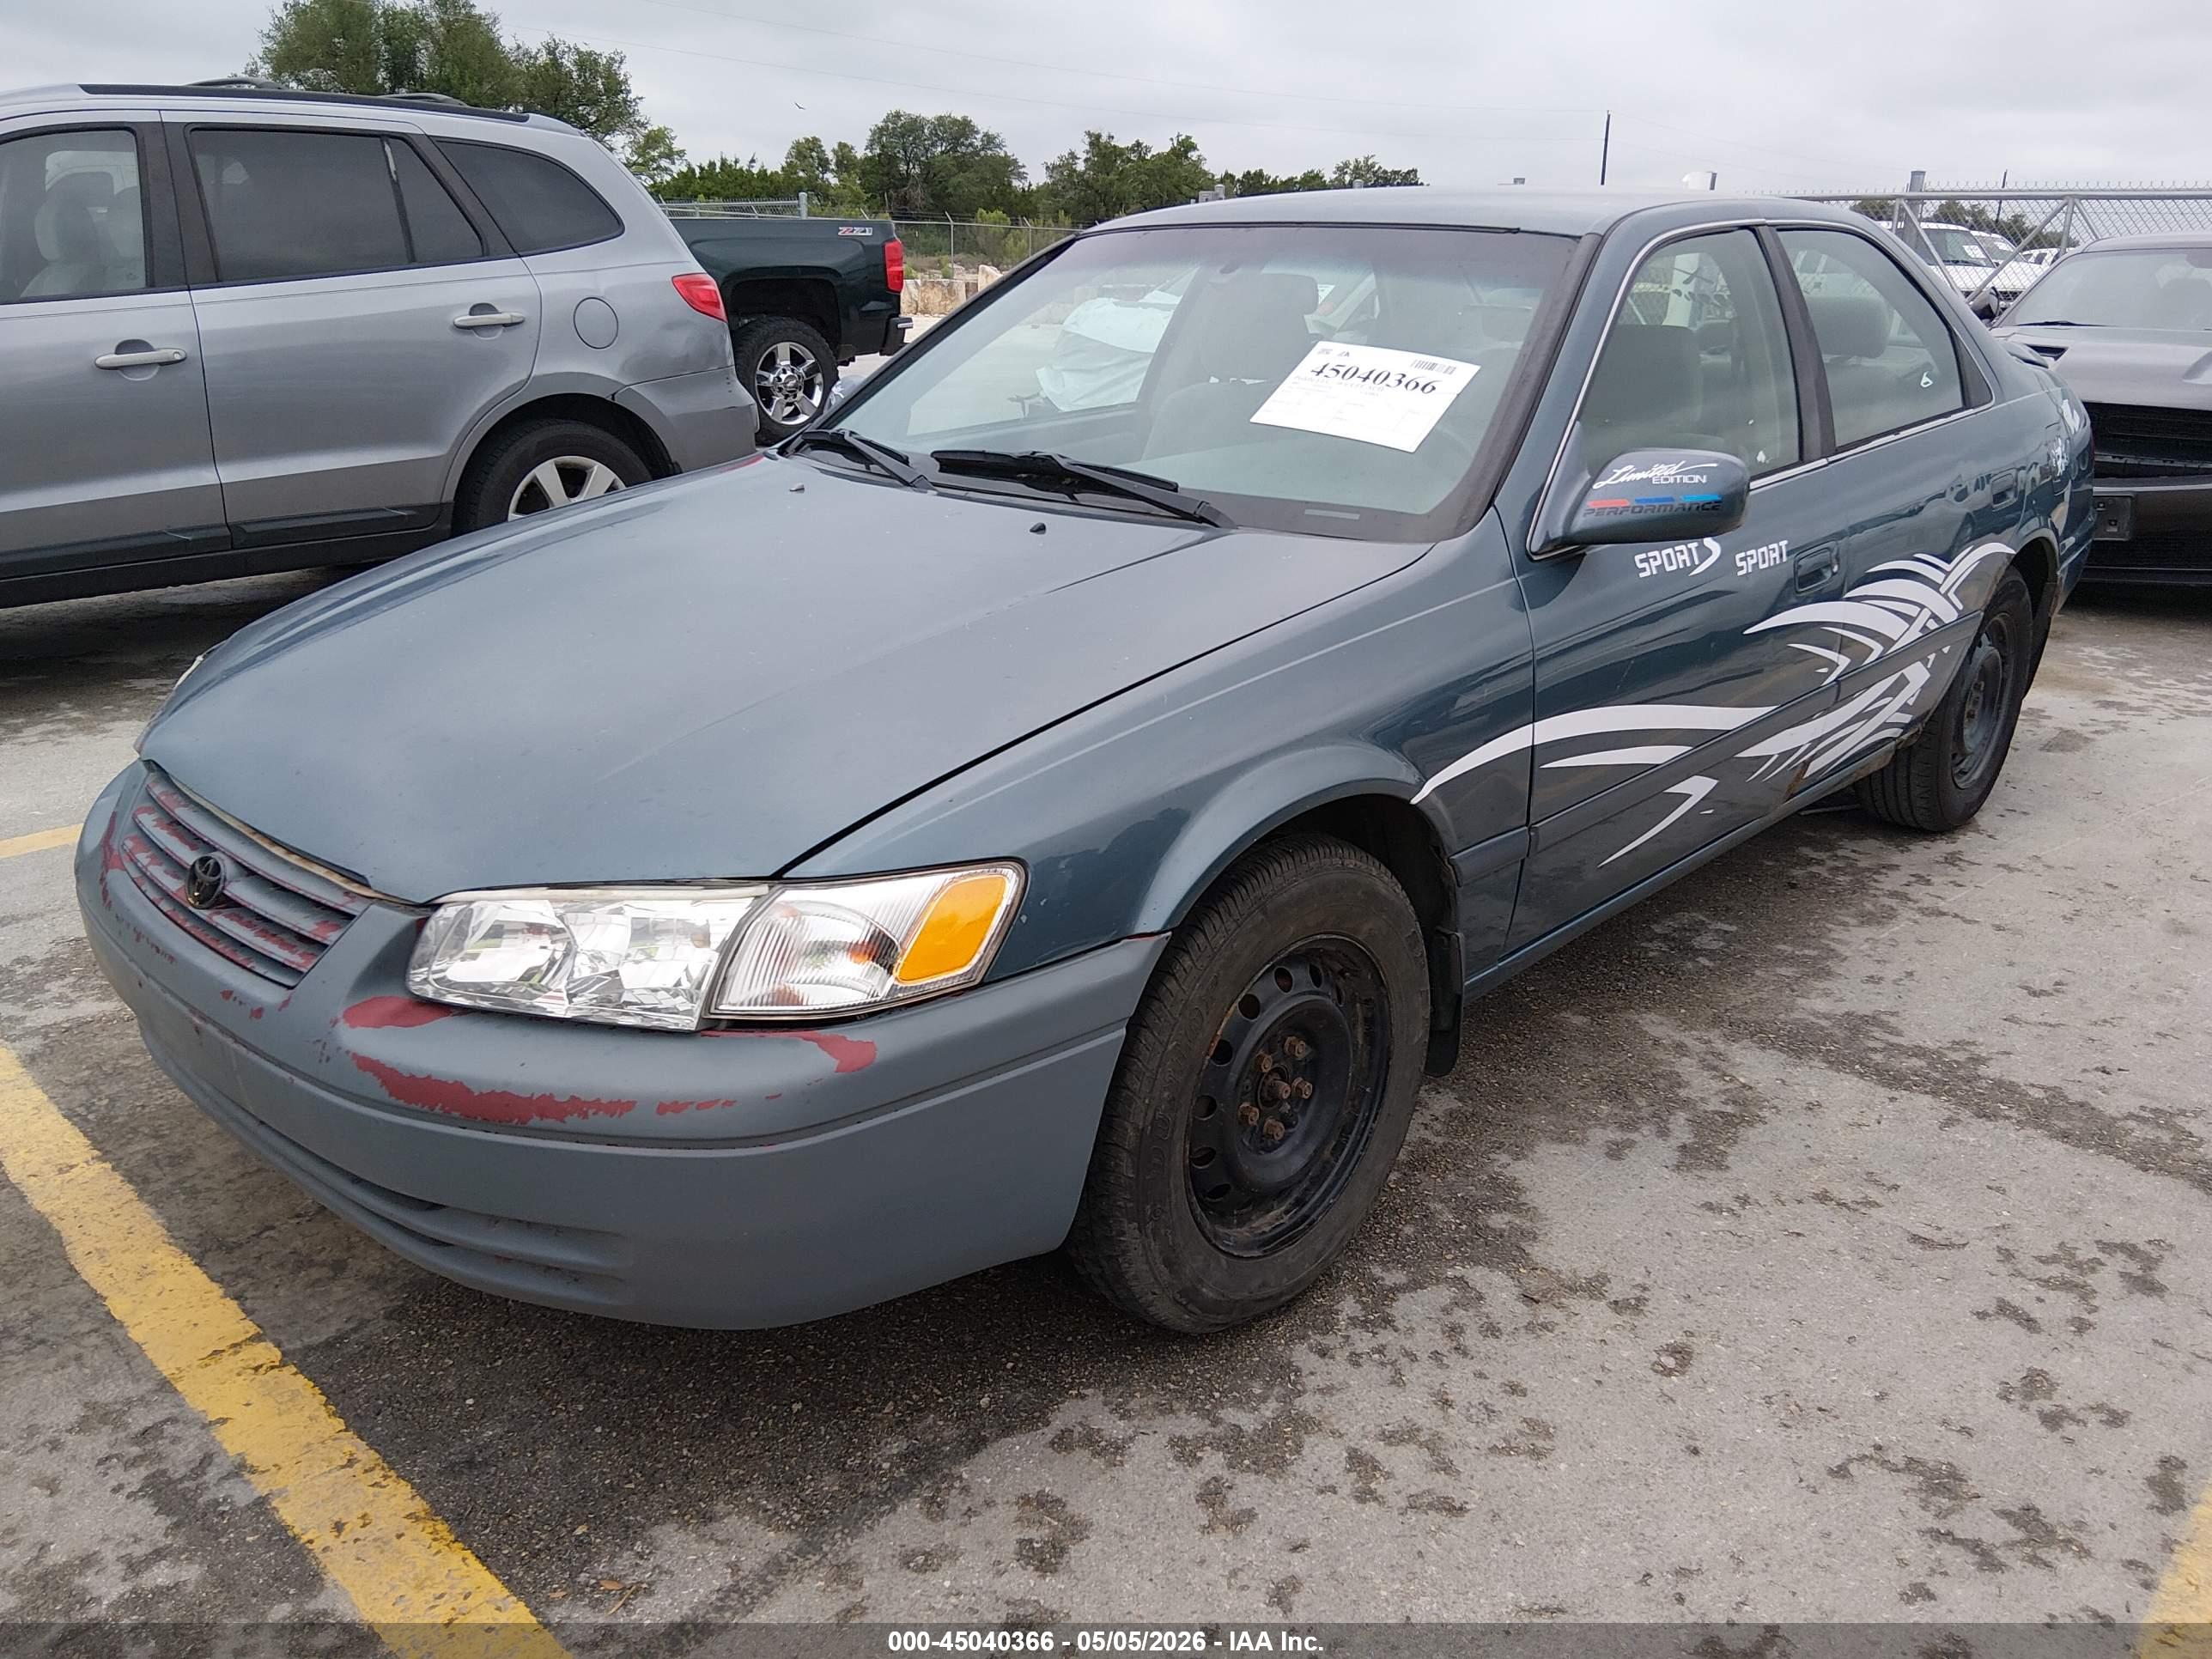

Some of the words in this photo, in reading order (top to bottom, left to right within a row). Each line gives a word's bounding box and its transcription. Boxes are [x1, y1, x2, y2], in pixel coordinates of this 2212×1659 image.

[1310, 362, 1443, 394] 45040366
[1593, 460, 1718, 489] Limited
[1652, 474, 1707, 484] EDITION
[1583, 501, 1723, 517] PERFORMANCE
[1735, 539, 1789, 576] SPORT
